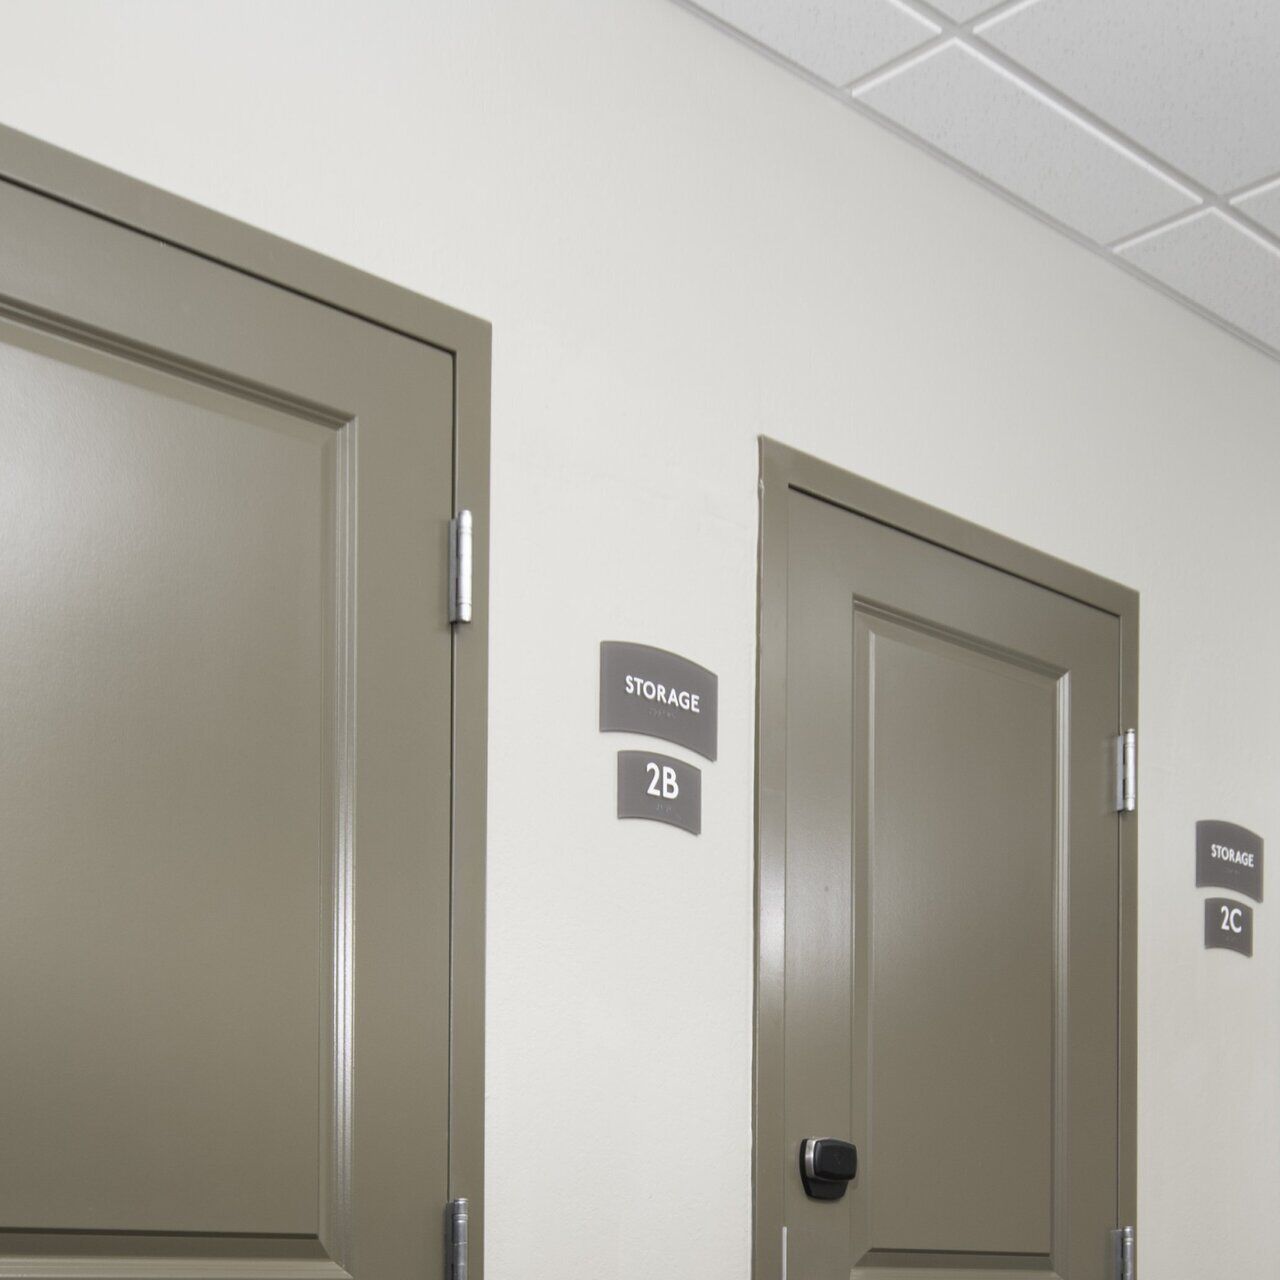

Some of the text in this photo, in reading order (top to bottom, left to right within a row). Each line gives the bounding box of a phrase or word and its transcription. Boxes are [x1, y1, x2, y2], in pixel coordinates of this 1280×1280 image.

[625, 674, 700, 713] STORAGE
[646, 762, 679, 799] 2B
[1211, 843, 1254, 868] STORAGE
[1221, 905, 1242, 934] 2C
